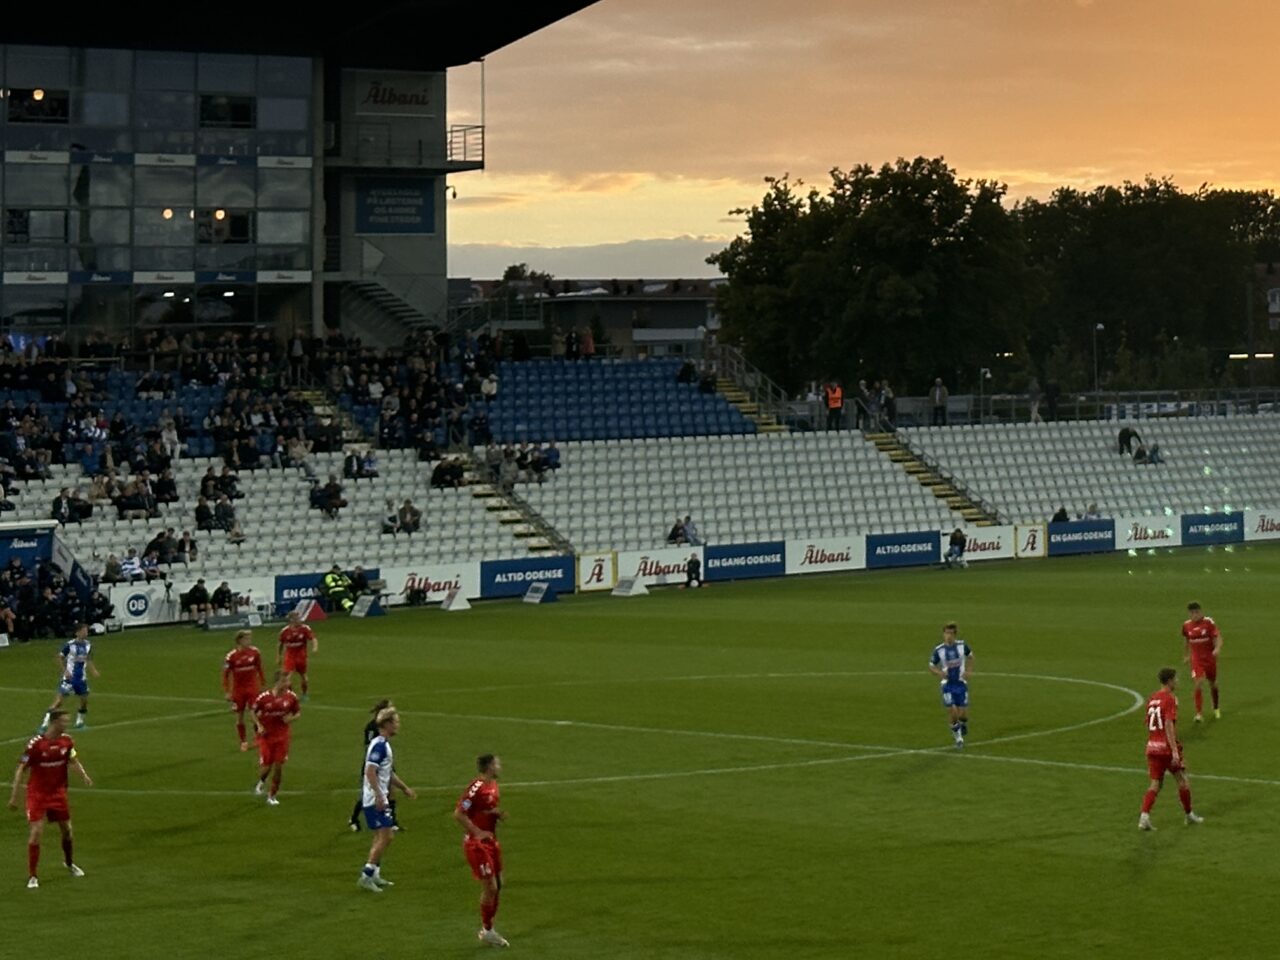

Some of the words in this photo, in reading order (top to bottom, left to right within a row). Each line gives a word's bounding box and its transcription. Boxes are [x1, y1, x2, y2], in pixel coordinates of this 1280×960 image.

[876, 544, 900, 554] ALTID
[901, 542, 933, 553] ODENSE
[708, 558, 720, 568] EN
[721, 556, 746, 567] GANG
[747, 553, 782, 565] ODENSE
[495, 571, 525, 583] ALTID
[525, 569, 564, 580] ODENSE
[283, 589, 298, 599] EN
[129, 598, 146, 612] OB
[1148, 706, 1163, 731] 21
